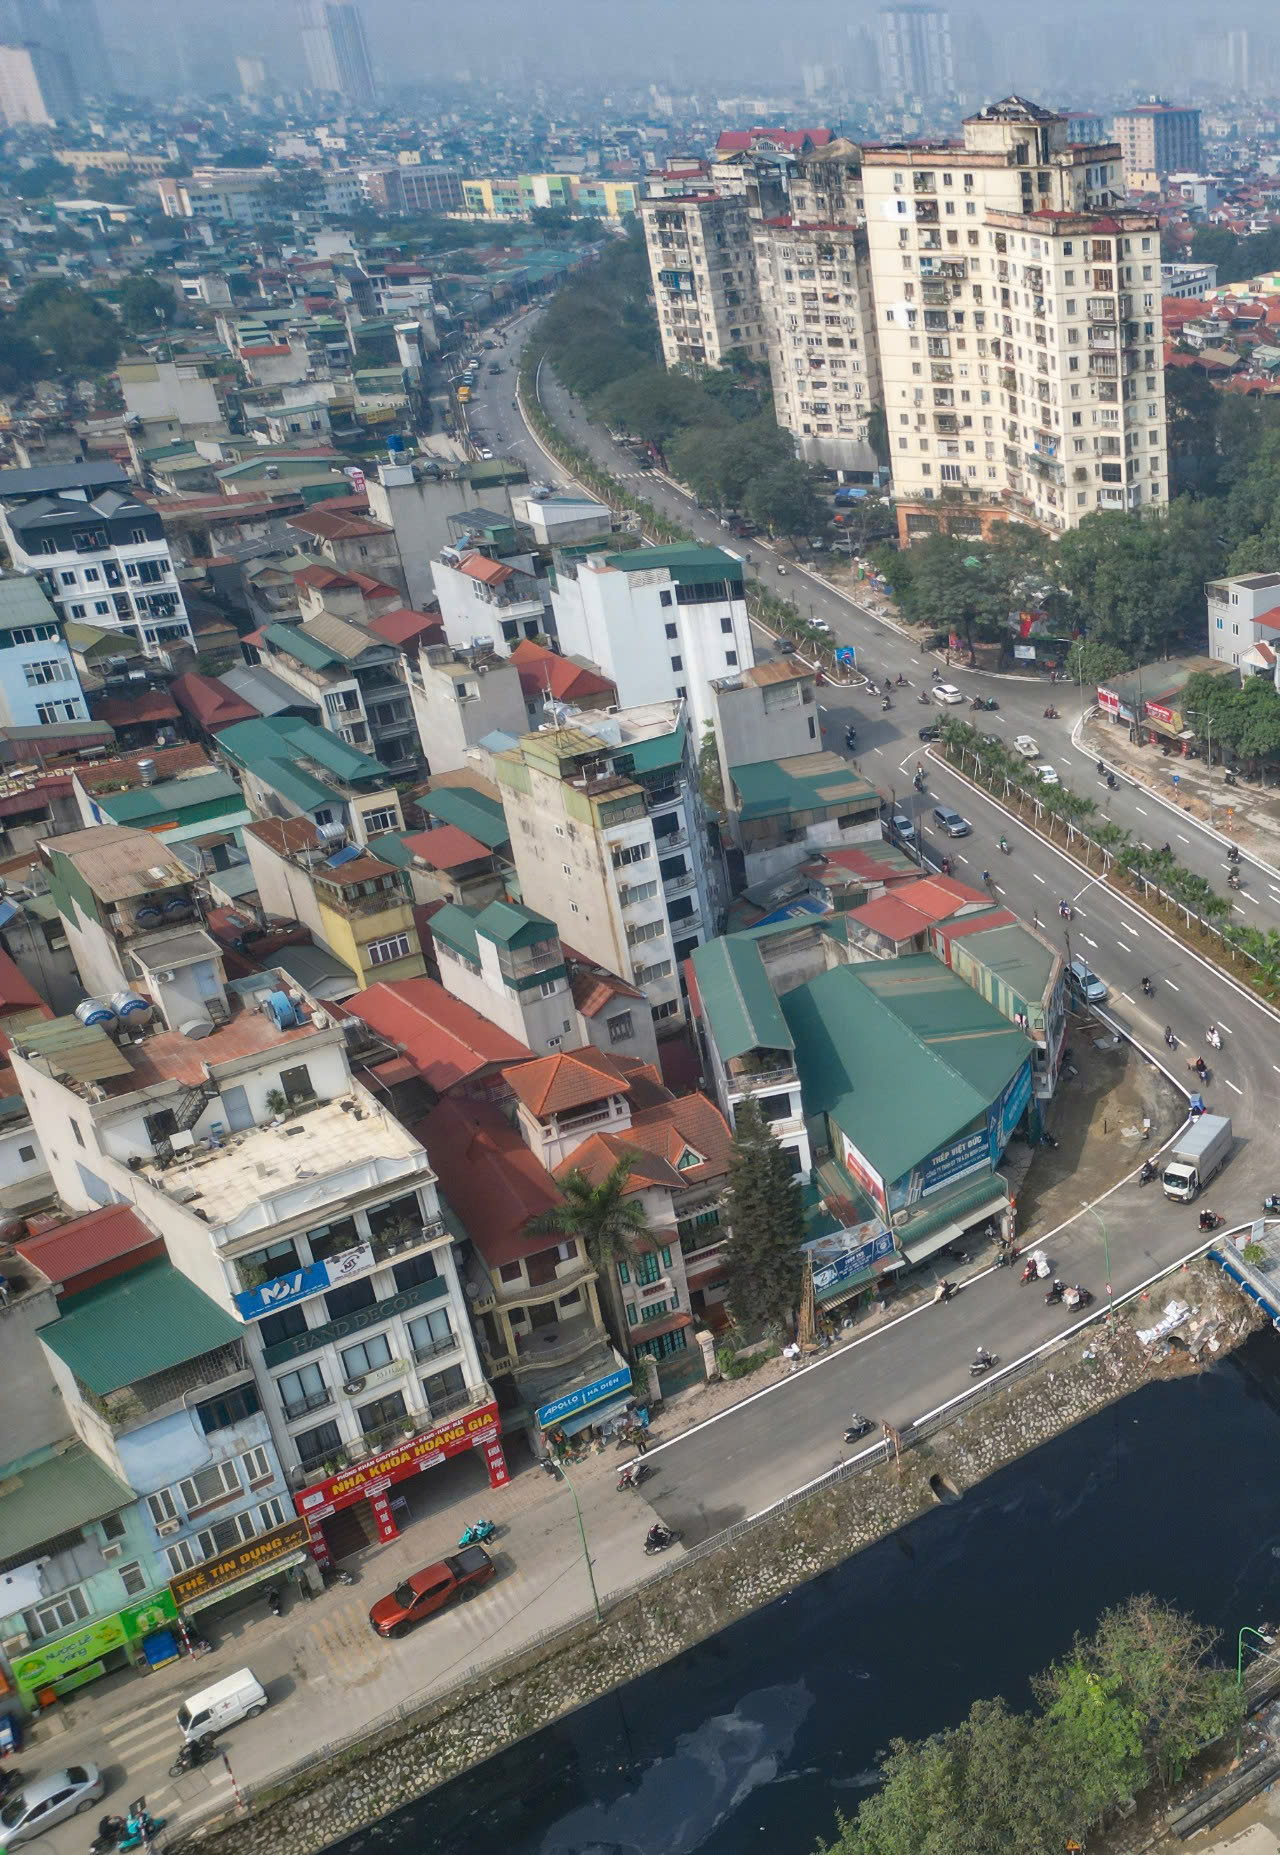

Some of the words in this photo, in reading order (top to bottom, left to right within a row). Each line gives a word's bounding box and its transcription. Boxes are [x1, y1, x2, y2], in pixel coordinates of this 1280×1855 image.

[292, 1321, 350, 1351] HAND
[353, 1291, 422, 1328] DECOR
[543, 1395, 579, 1418] APOLLO
[331, 1473, 368, 1496] NHA
[368, 1452, 411, 1477] KHOA
[469, 1413, 494, 1432] GIA
[210, 1558, 237, 1579] TÍN
